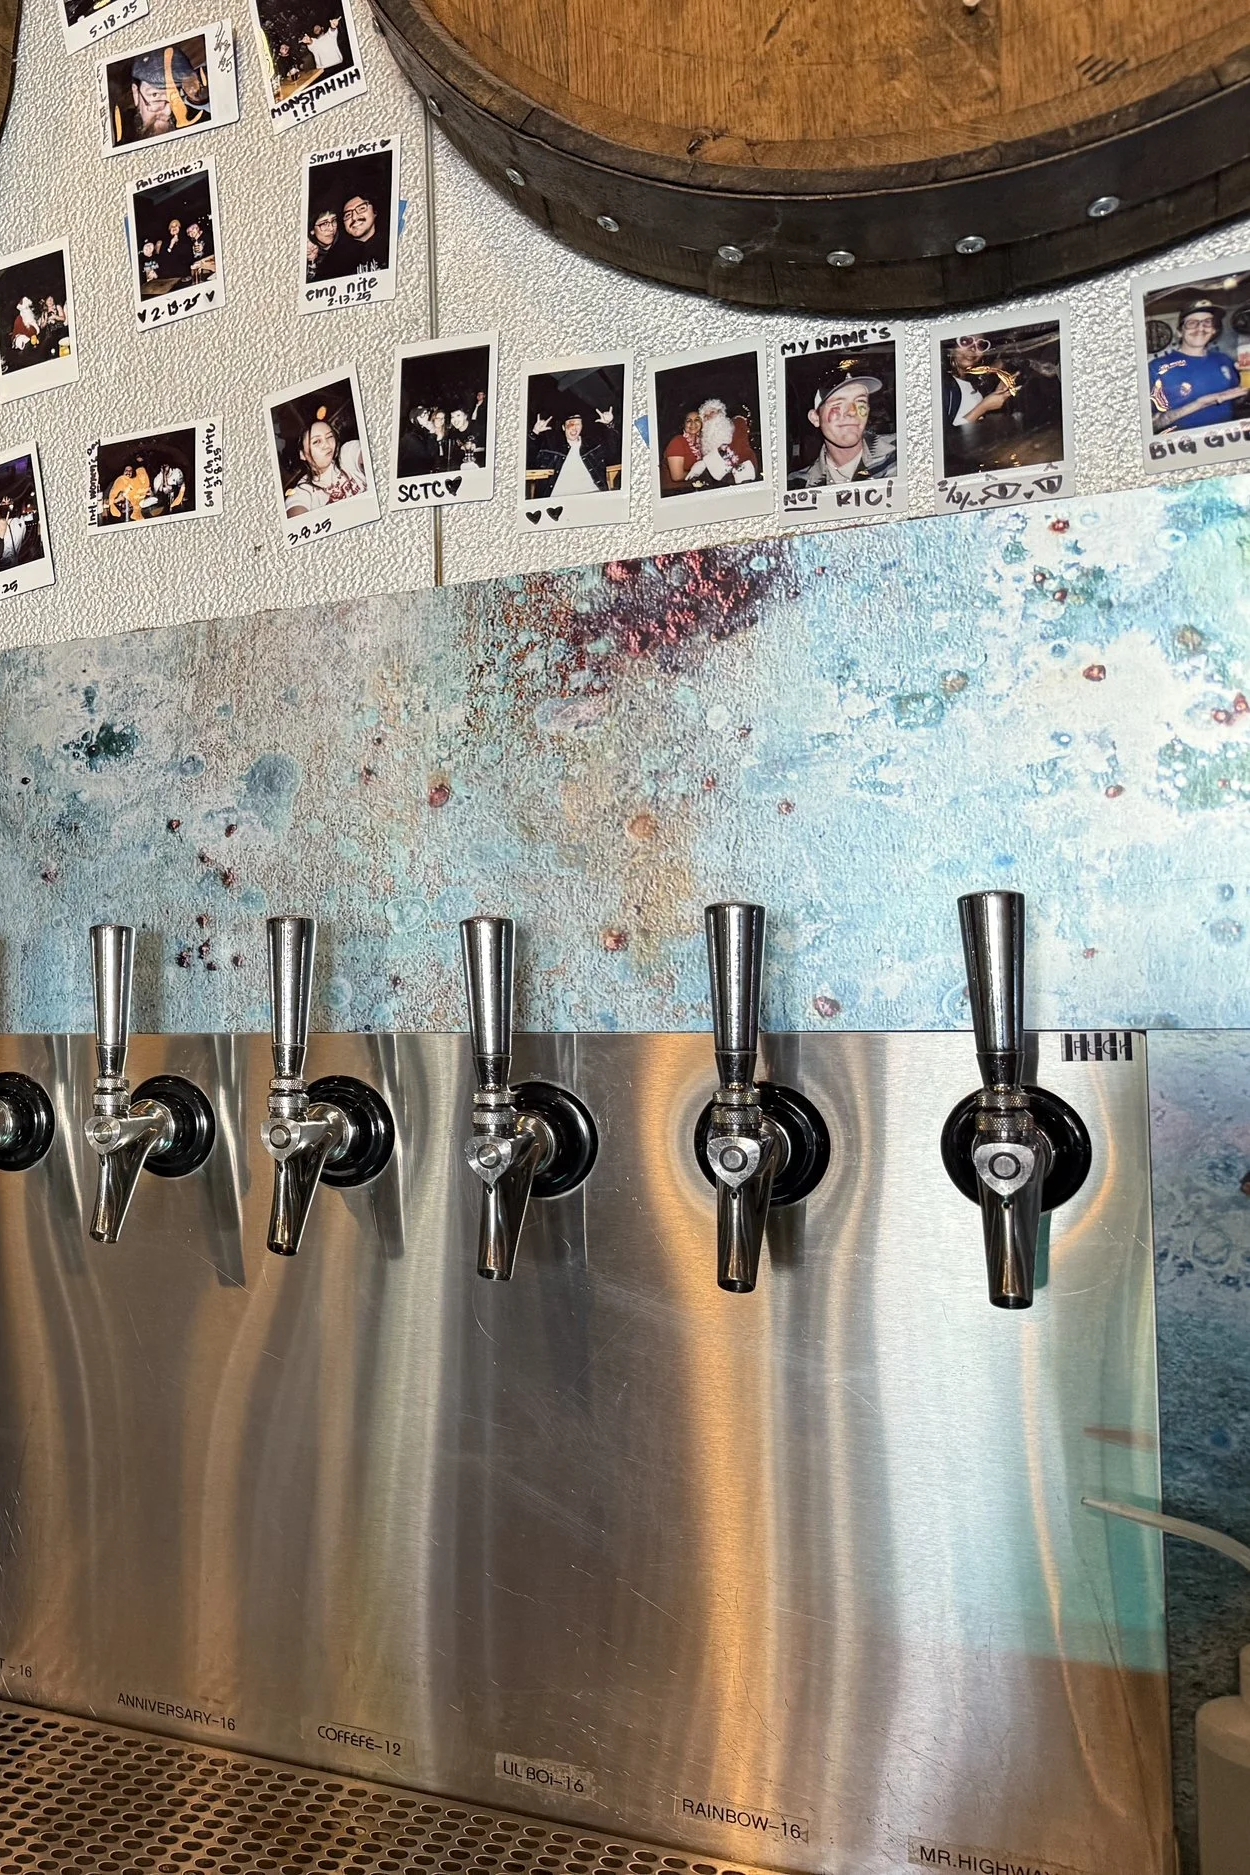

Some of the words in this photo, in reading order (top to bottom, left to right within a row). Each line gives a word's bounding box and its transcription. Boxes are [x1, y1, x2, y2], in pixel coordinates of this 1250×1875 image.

[88, 2, 138, 39] 5-18-25
[270, 68, 361, 119] MONSTAHHH
[305, 285, 338, 301] emo
[346, 275, 379, 294] nite
[780, 341, 809, 356] MY
[814, 326, 892, 351] NAME'S
[1149, 436, 1198, 461] BIG
[398, 480, 445, 502] SCTC
[783, 489, 823, 506] NOT
[836, 480, 894, 508] RIC!
[287, 518, 332, 545] 3.8.25
[19, 1664, 32, 1678] 16
[117, 1692, 236, 1732] ANNIVERSARY-16
[682, 1798, 801, 1840] RAINBOW-16
[919, 1845, 1060, 1875] MR.HIGHW
